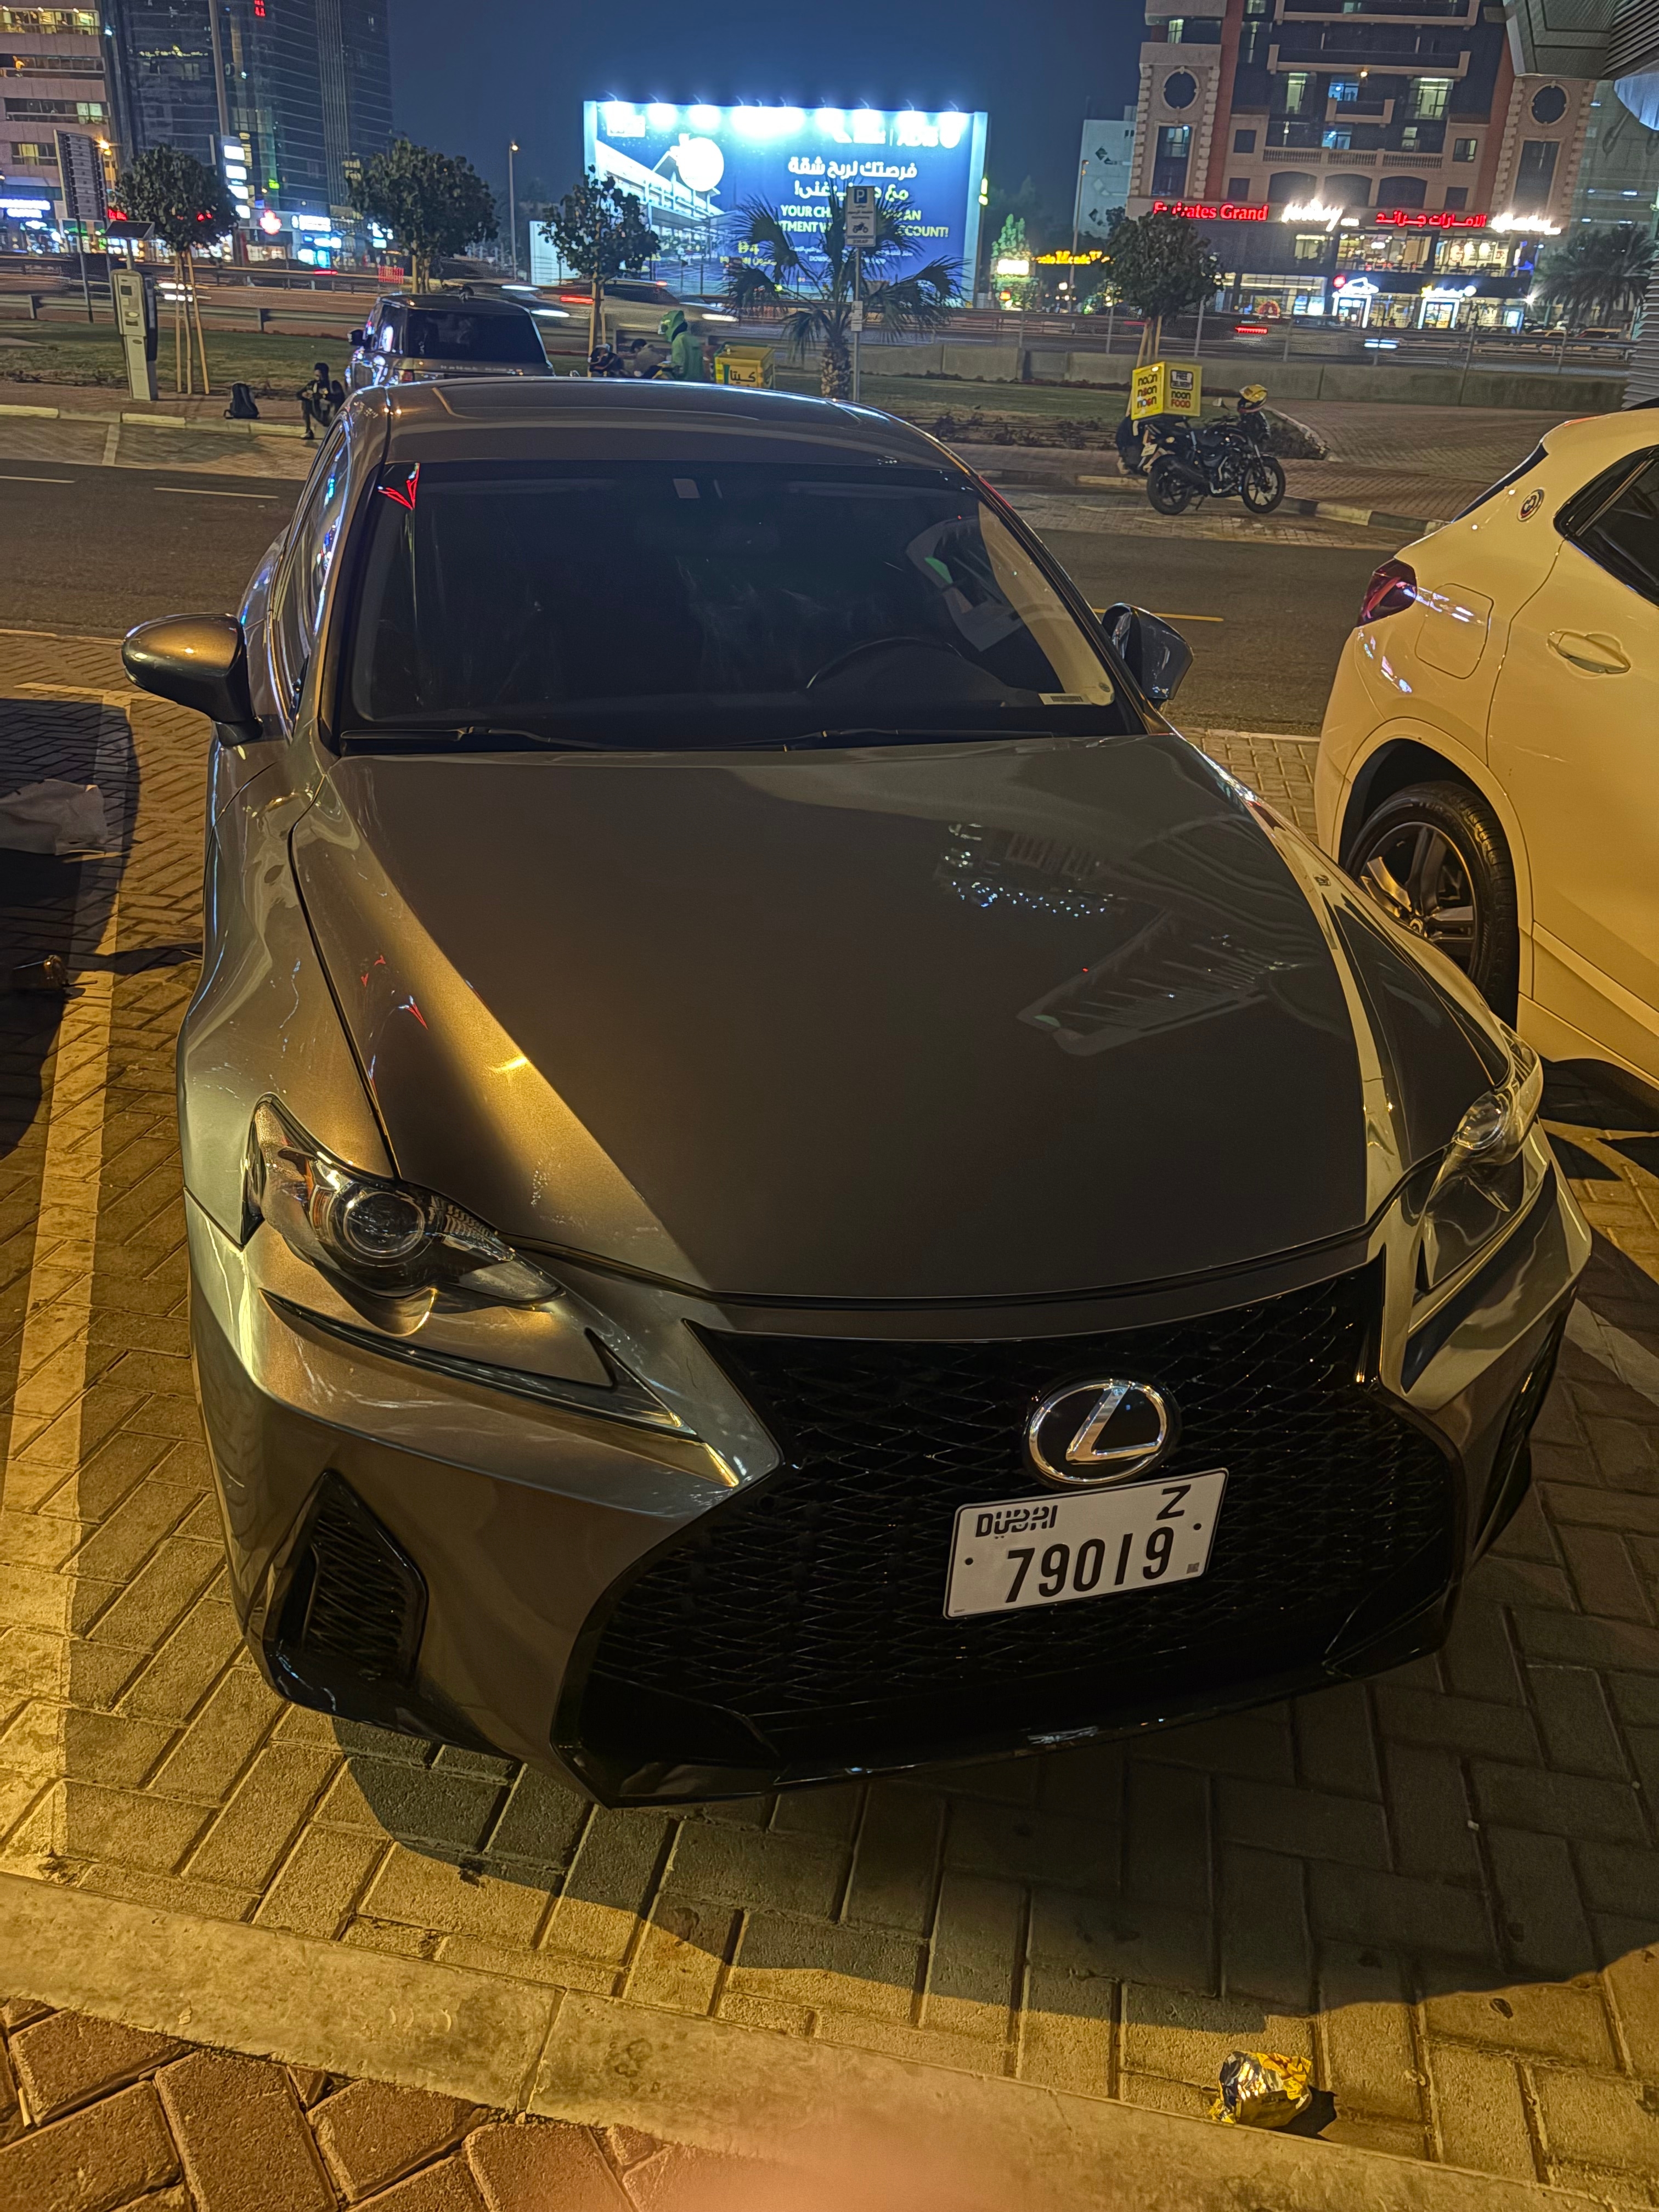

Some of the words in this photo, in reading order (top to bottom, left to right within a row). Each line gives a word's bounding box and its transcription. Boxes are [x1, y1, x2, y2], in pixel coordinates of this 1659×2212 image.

[788, 156, 826, 175] شقة
[827, 160, 858, 179] لربح
[860, 161, 917, 180] فرصتك
[856, 189, 865, 202] P
[780, 205, 812, 217] YOUR
[903, 210, 922, 221] AN
[1220, 203, 1269, 221] Grand
[774, 220, 819, 233] TMENT
[730, 370, 756, 384] كيتا
[1171, 391, 1191, 400] noon
[1171, 398, 1191, 409] FOOD
[975, 1505, 1058, 1538] DUBAI
[1155, 1484, 1192, 1521] Z
[1005, 1526, 1175, 1604] 79019
